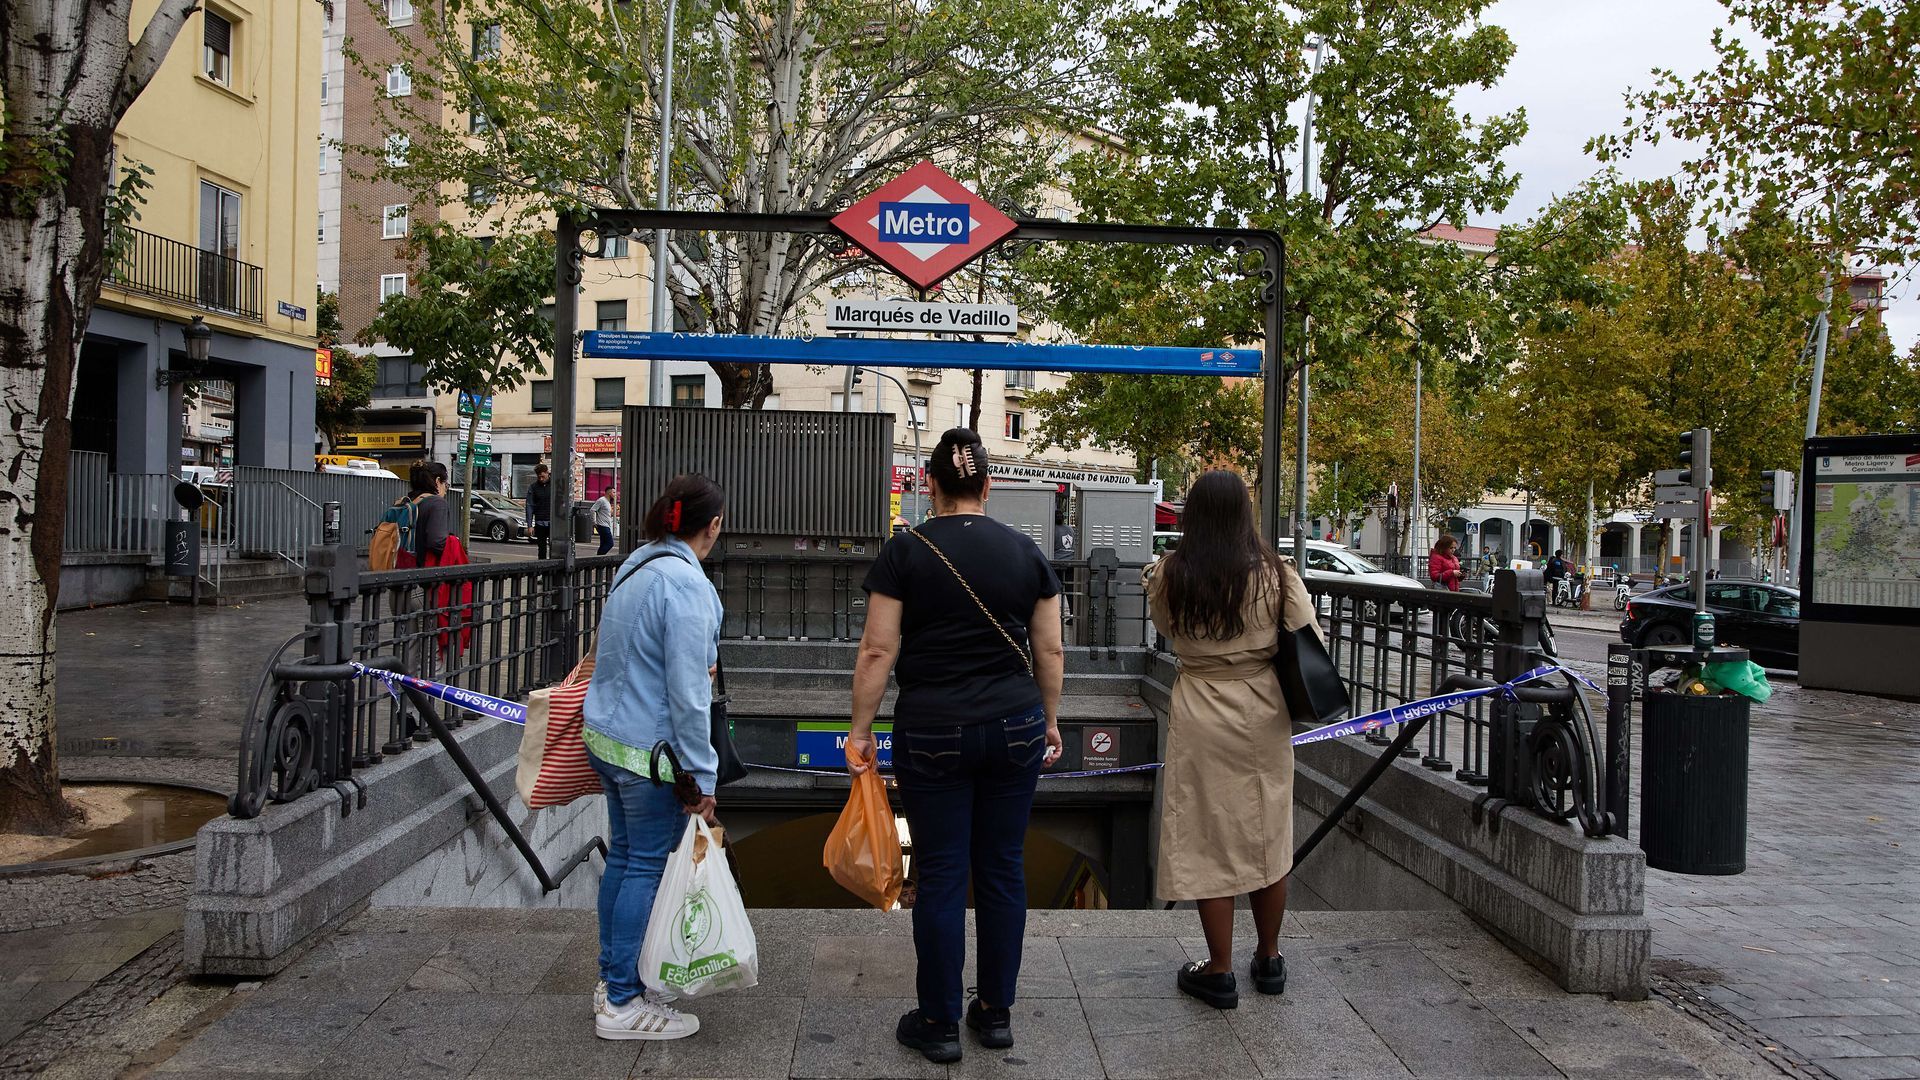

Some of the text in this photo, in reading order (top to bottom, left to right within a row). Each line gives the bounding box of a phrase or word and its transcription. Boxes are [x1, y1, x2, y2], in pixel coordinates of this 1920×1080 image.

[884, 209, 963, 236] Metro
[835, 305, 1010, 326] Marqués de Vadillo
[896, 466, 920, 475] PHON
[988, 465, 1130, 484] GRAN NEMRUT MARQUES DE VADILLO
[454, 690, 522, 719] NO PASAR
[1403, 702, 1446, 719] PASAR
[1336, 726, 1356, 738] NO
[801, 755, 807, 763] 5
